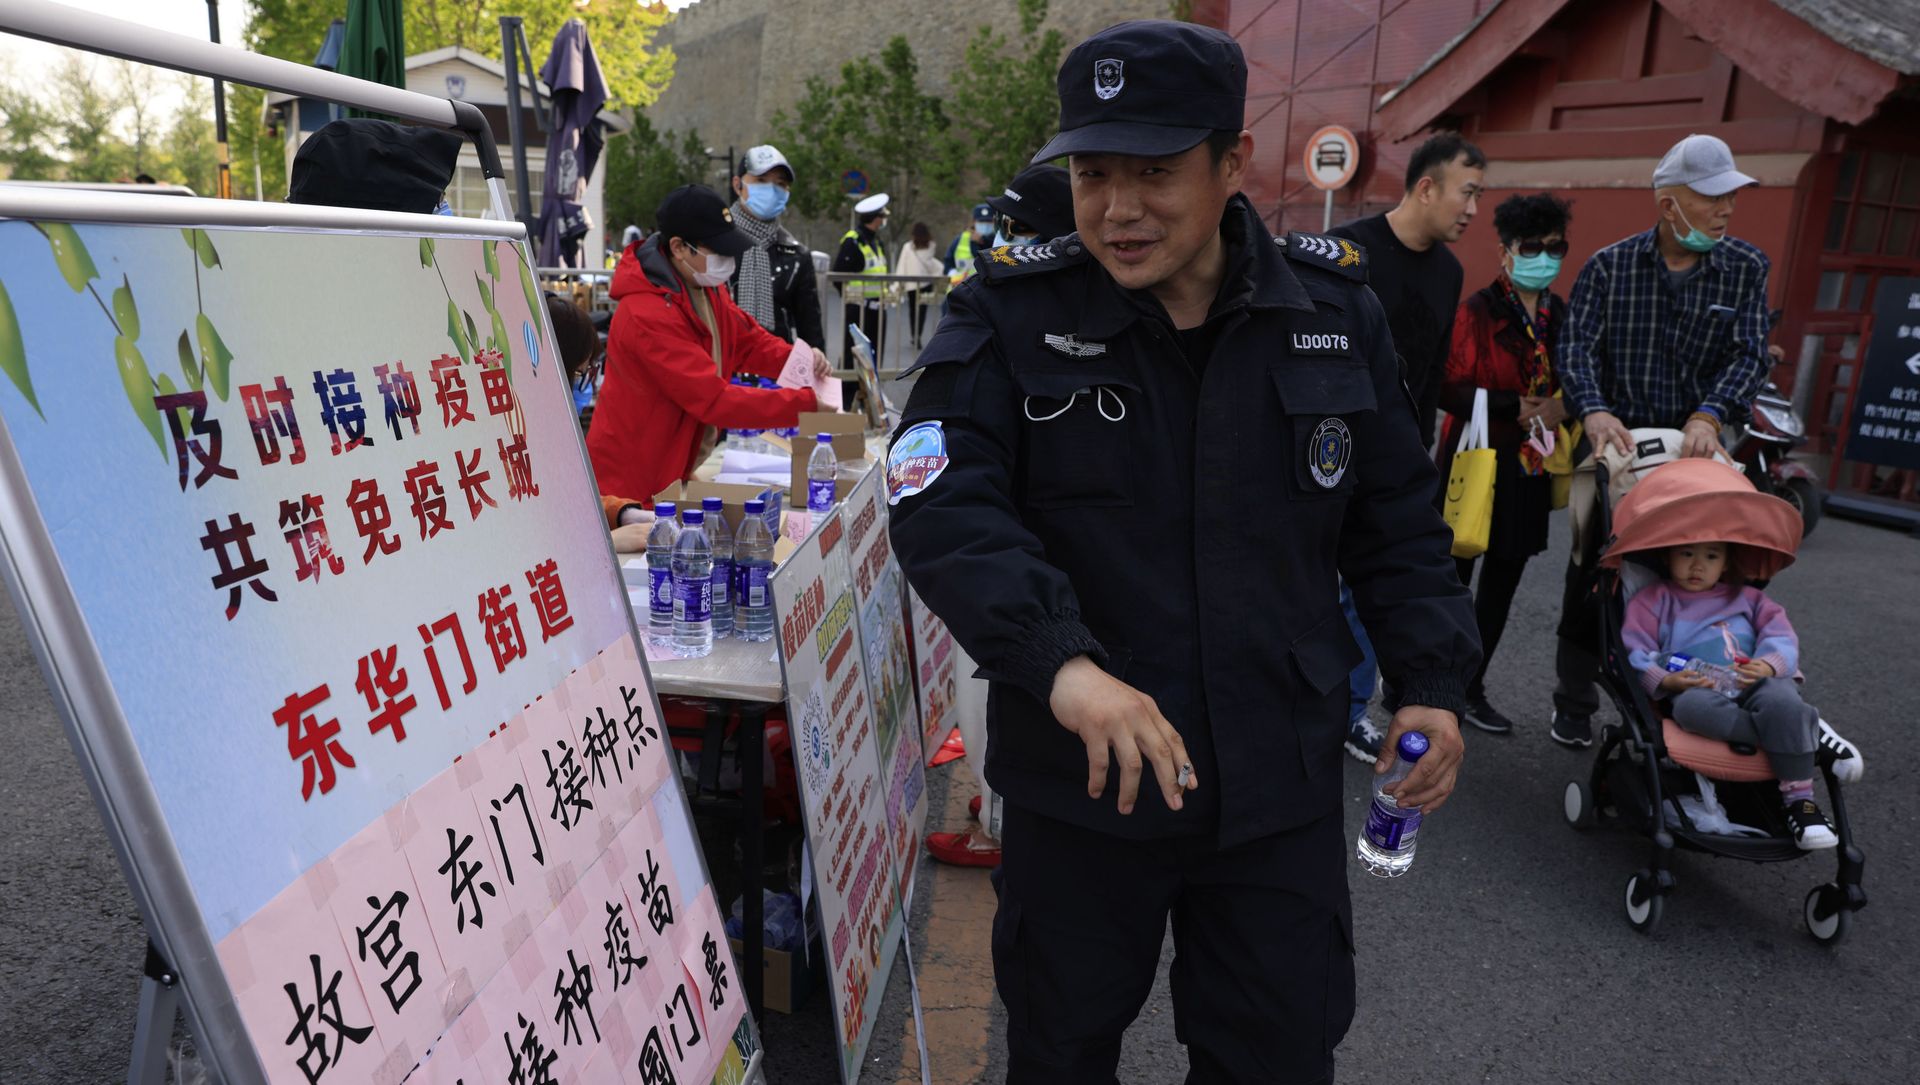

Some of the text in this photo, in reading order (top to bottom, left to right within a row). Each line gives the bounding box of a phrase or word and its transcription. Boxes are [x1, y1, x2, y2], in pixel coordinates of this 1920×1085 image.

[155, 347, 517, 493] 及时接种疫苗
[1293, 333, 1349, 350] LD0076
[200, 433, 539, 621] 共筑免疫长城
[272, 558, 574, 802] 东华门街道
[283, 685, 658, 1085] 故宫东门接种点
[456, 849, 674, 1085] 接种疫苗
